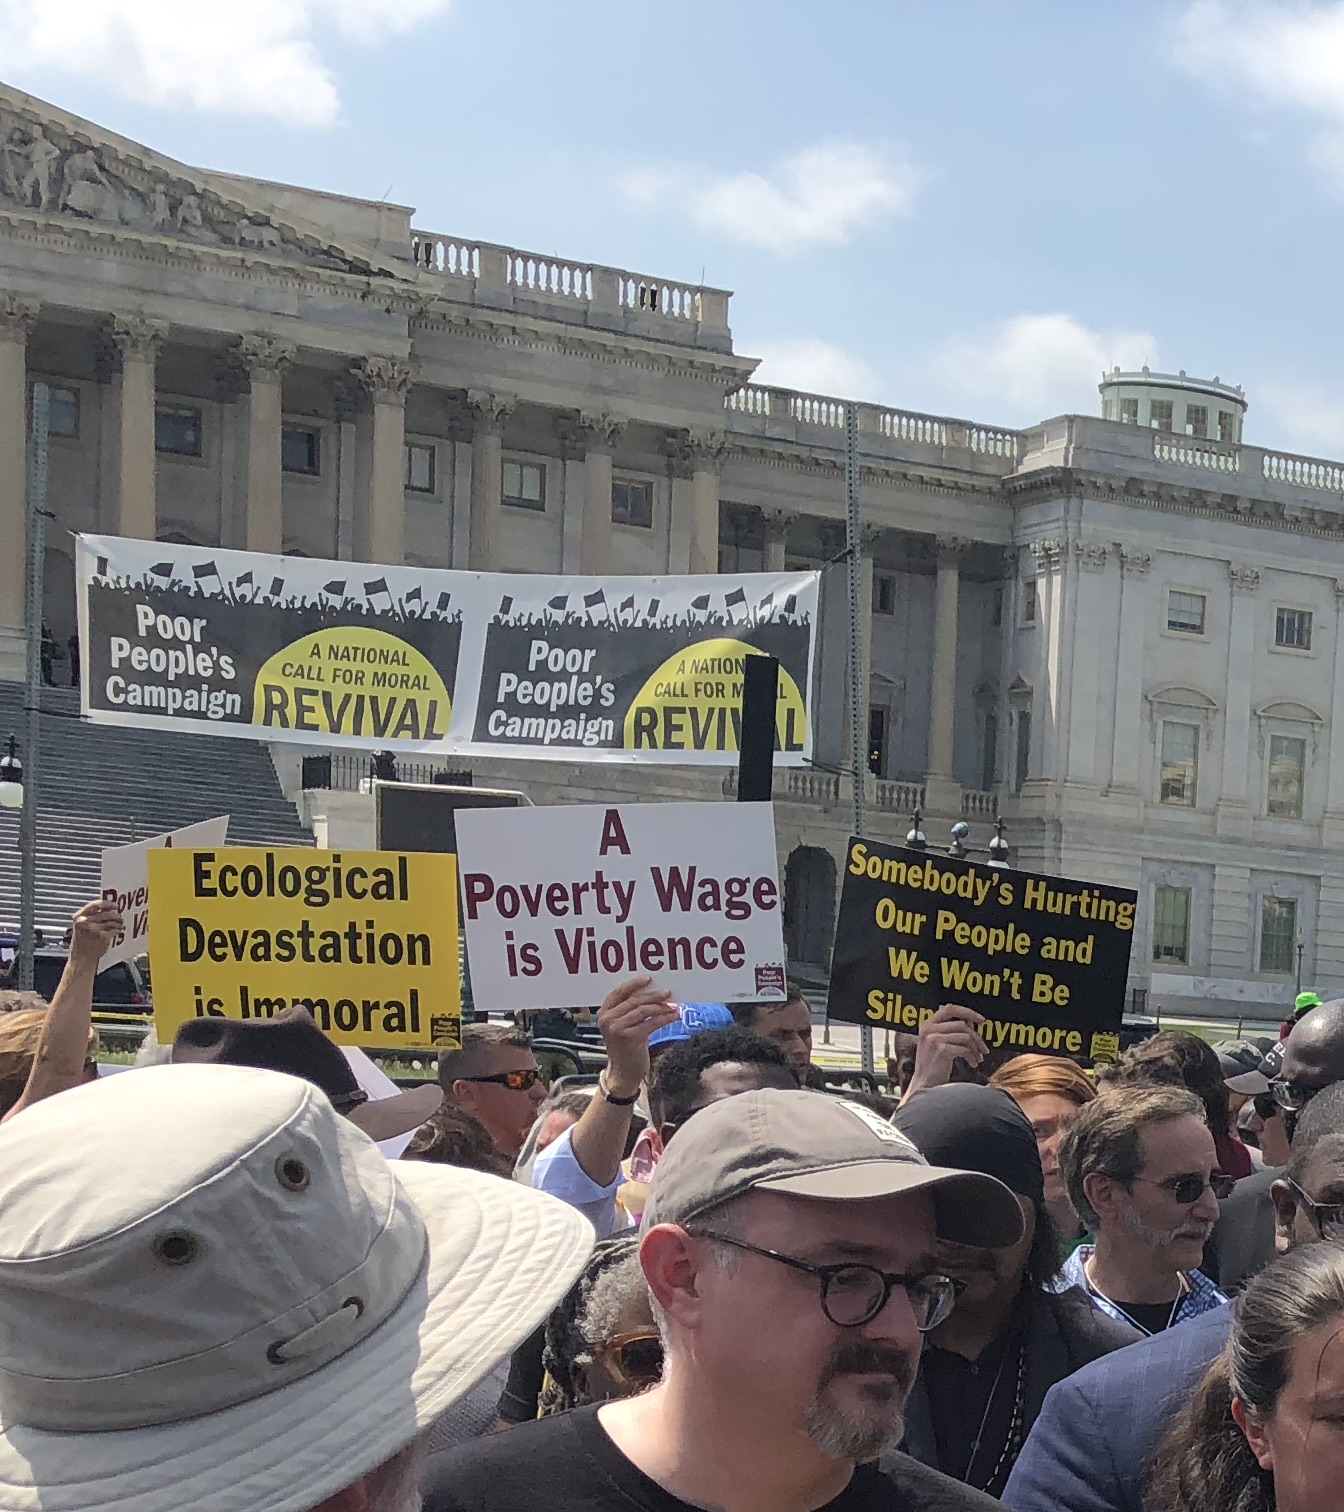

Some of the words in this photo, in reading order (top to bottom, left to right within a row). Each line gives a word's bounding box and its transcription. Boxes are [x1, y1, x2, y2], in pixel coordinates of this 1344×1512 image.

[136, 604, 207, 643] Poor
[110, 637, 236, 681] People's
[281, 663, 325, 682] CALL
[332, 668, 366, 686] FOR
[371, 672, 431, 691] MORAL
[309, 643, 322, 660] A
[328, 644, 410, 667] NATIONAL
[528, 640, 597, 673] Poor
[676, 660, 687, 675] A
[690, 657, 746, 676] NATION
[106, 676, 242, 719] Campaign
[262, 684, 447, 741] REVIVAL
[496, 673, 616, 712] People's
[653, 682, 689, 698] CALL
[694, 682, 726, 698] FOR
[487, 710, 615, 746] Campaign
[600, 809, 631, 855] A
[193, 852, 409, 907] Ecological
[464, 870, 636, 923] Poverty
[650, 865, 778, 921] Wage
[849, 844, 1014, 906] Somebody's
[1024, 879, 1136, 930] Hurting
[179, 918, 431, 965] Devastation
[505, 931, 542, 977] is
[555, 925, 745, 975] Violence
[876, 898, 927, 936] Our
[935, 910, 1031, 955] People
[1040, 935, 1094, 965] and
[888, 947, 930, 984] We
[940, 957, 1022, 1000] Won't
[1032, 973, 1070, 1006] Be
[194, 986, 226, 1018] is
[240, 985, 420, 1033] Immoral
[866, 990, 937, 1027] Silen
[976, 1016, 1082, 1052] nymore
